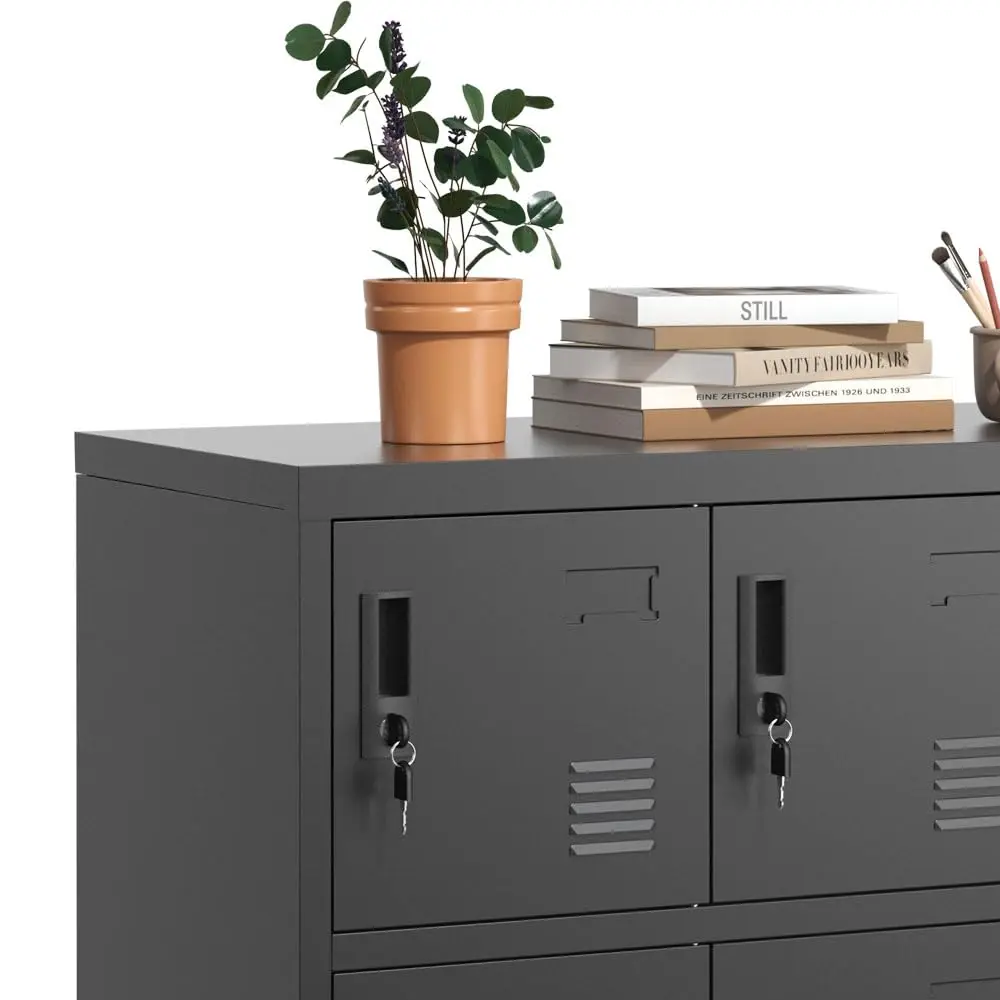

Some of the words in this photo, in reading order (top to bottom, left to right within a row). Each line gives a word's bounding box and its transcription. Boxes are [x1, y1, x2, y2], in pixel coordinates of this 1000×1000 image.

[741, 300, 788, 321] STILL
[763, 356, 809, 375] VANITY
[697, 393, 719, 401] EINE
[721, 391, 783, 400] ZEITSCHRIFT
[785, 389, 838, 398] ZWISCHEN
[842, 388, 863, 396] 1926
[865, 387, 887, 395] UND
[890, 386, 911, 394] 1933
